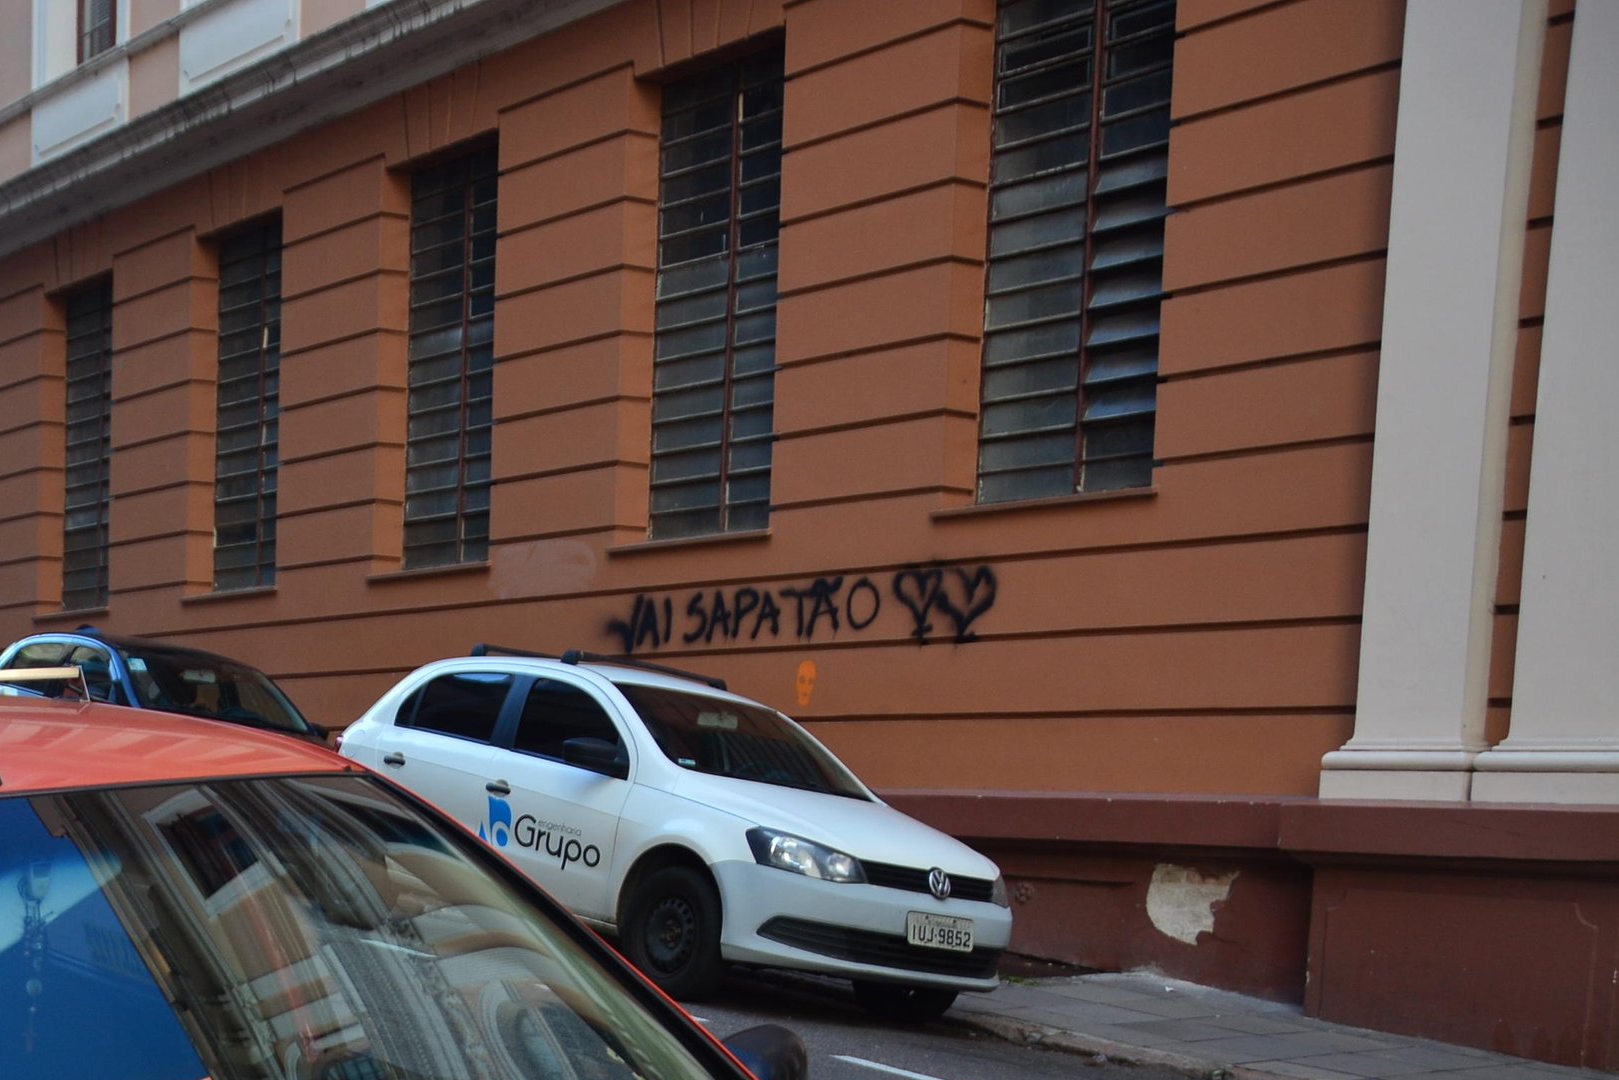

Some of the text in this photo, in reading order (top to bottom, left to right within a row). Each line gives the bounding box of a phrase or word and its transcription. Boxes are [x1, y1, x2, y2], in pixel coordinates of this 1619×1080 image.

[608, 593, 673, 655] VAI
[514, 814, 601, 870] Grupo
[538, 819, 582, 837] engenharia
